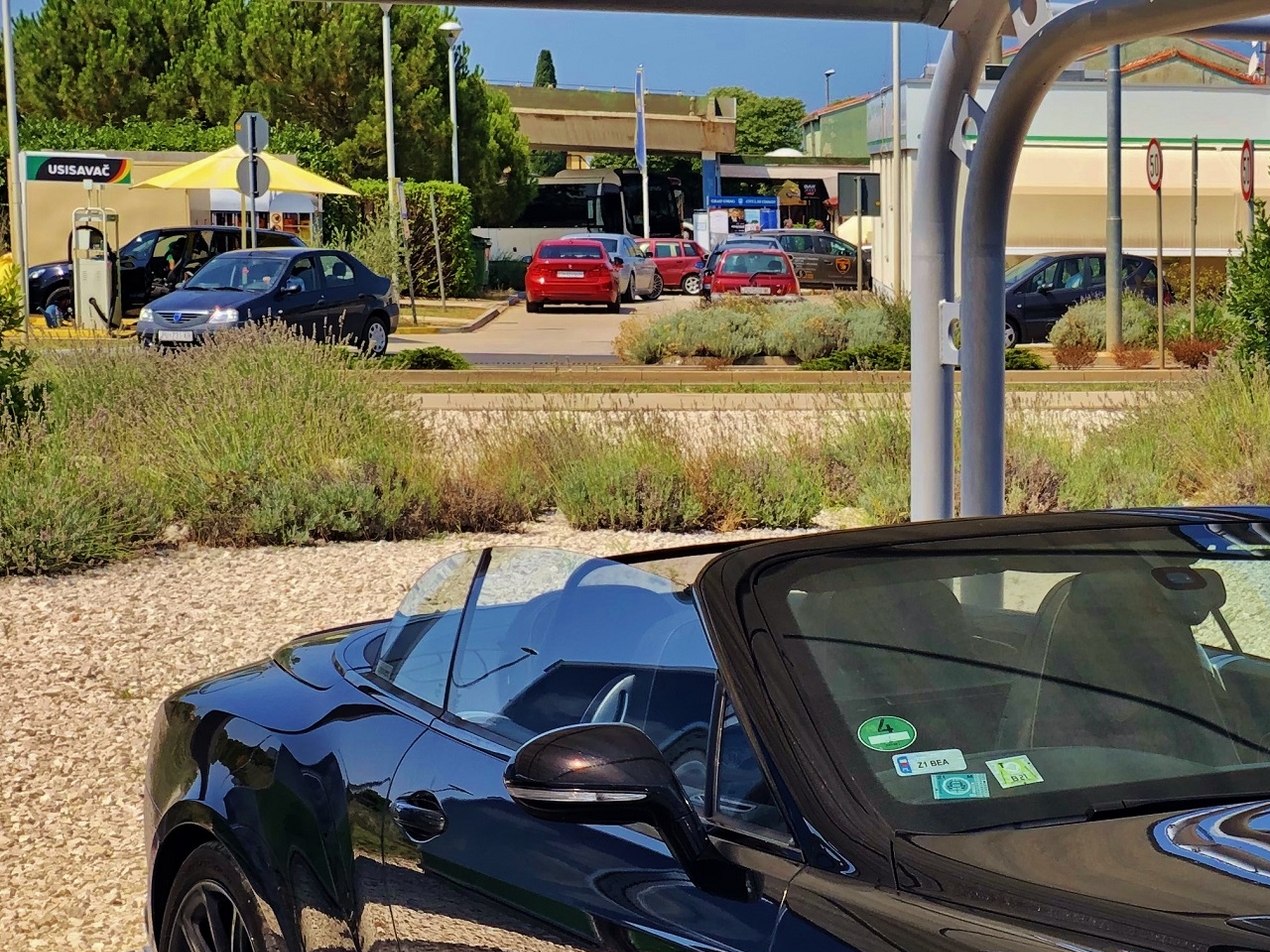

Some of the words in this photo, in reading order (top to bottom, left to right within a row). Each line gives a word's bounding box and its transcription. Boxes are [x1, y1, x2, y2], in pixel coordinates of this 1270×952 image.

[48, 163, 111, 177] USISAVAČ
[1149, 153, 1159, 177] 50
[878, 718, 894, 733] 4
[930, 759, 950, 767] BEA
